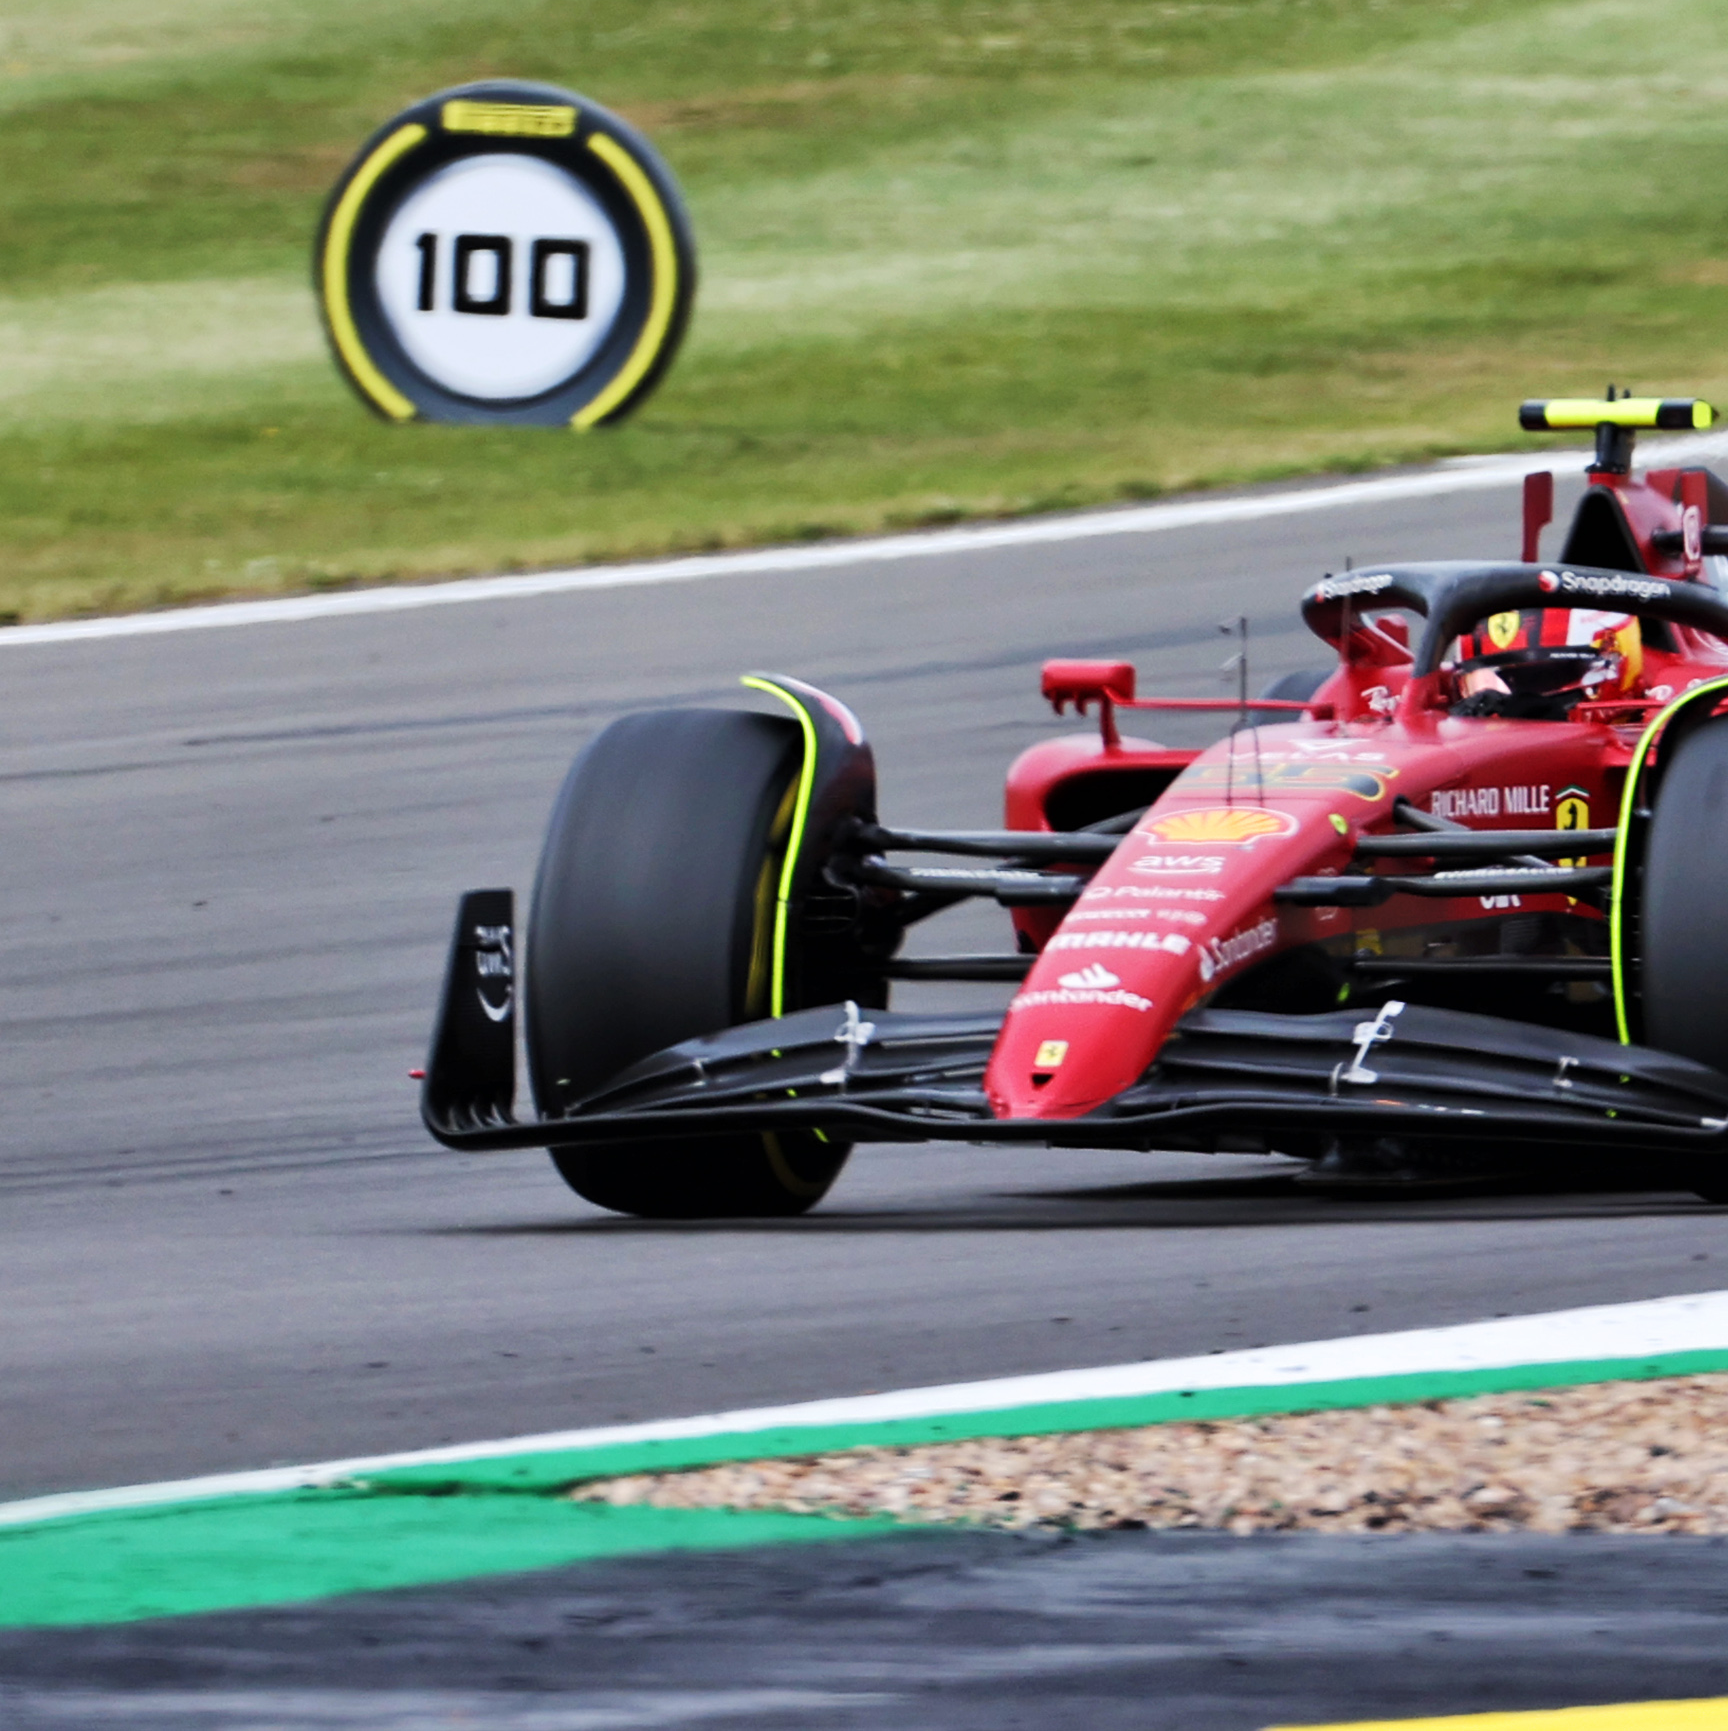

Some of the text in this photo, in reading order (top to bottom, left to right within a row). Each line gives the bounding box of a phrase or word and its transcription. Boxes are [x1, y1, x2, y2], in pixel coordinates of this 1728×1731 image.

[416, 232, 591, 321] 100
[1560, 571, 1671, 603] Snapdragon
[1431, 784, 1550, 817] RICHARD MILLE
[1135, 855, 1226, 869] aws
[1044, 930, 1192, 956] MAHLE
